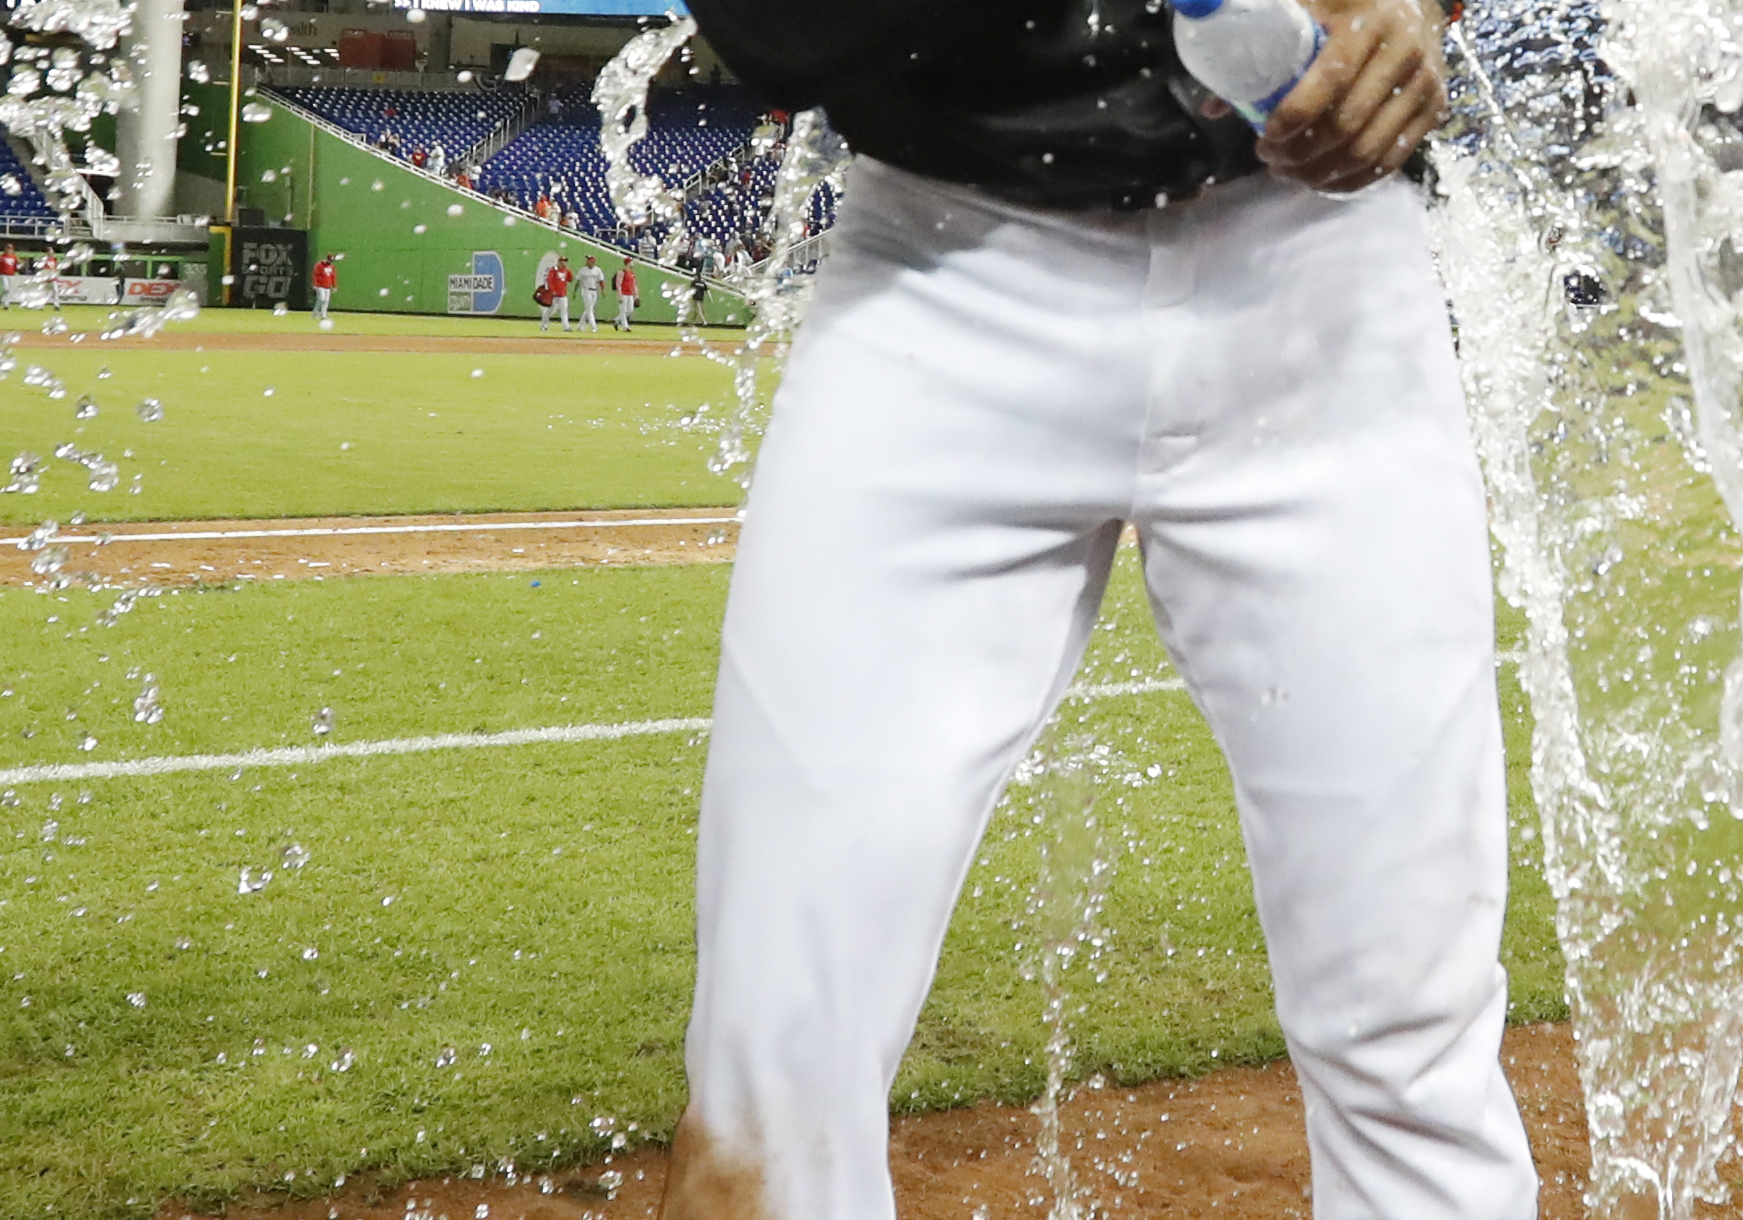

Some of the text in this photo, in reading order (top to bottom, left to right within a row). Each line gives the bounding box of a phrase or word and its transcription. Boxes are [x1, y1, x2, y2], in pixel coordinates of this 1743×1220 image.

[413, 0, 419, 9] I
[507, 0, 541, 13] KIND
[242, 242, 293, 266] FOX
[182, 263, 208, 275] 335
[242, 275, 292, 299] GO
[473, 277, 494, 290] DADE
